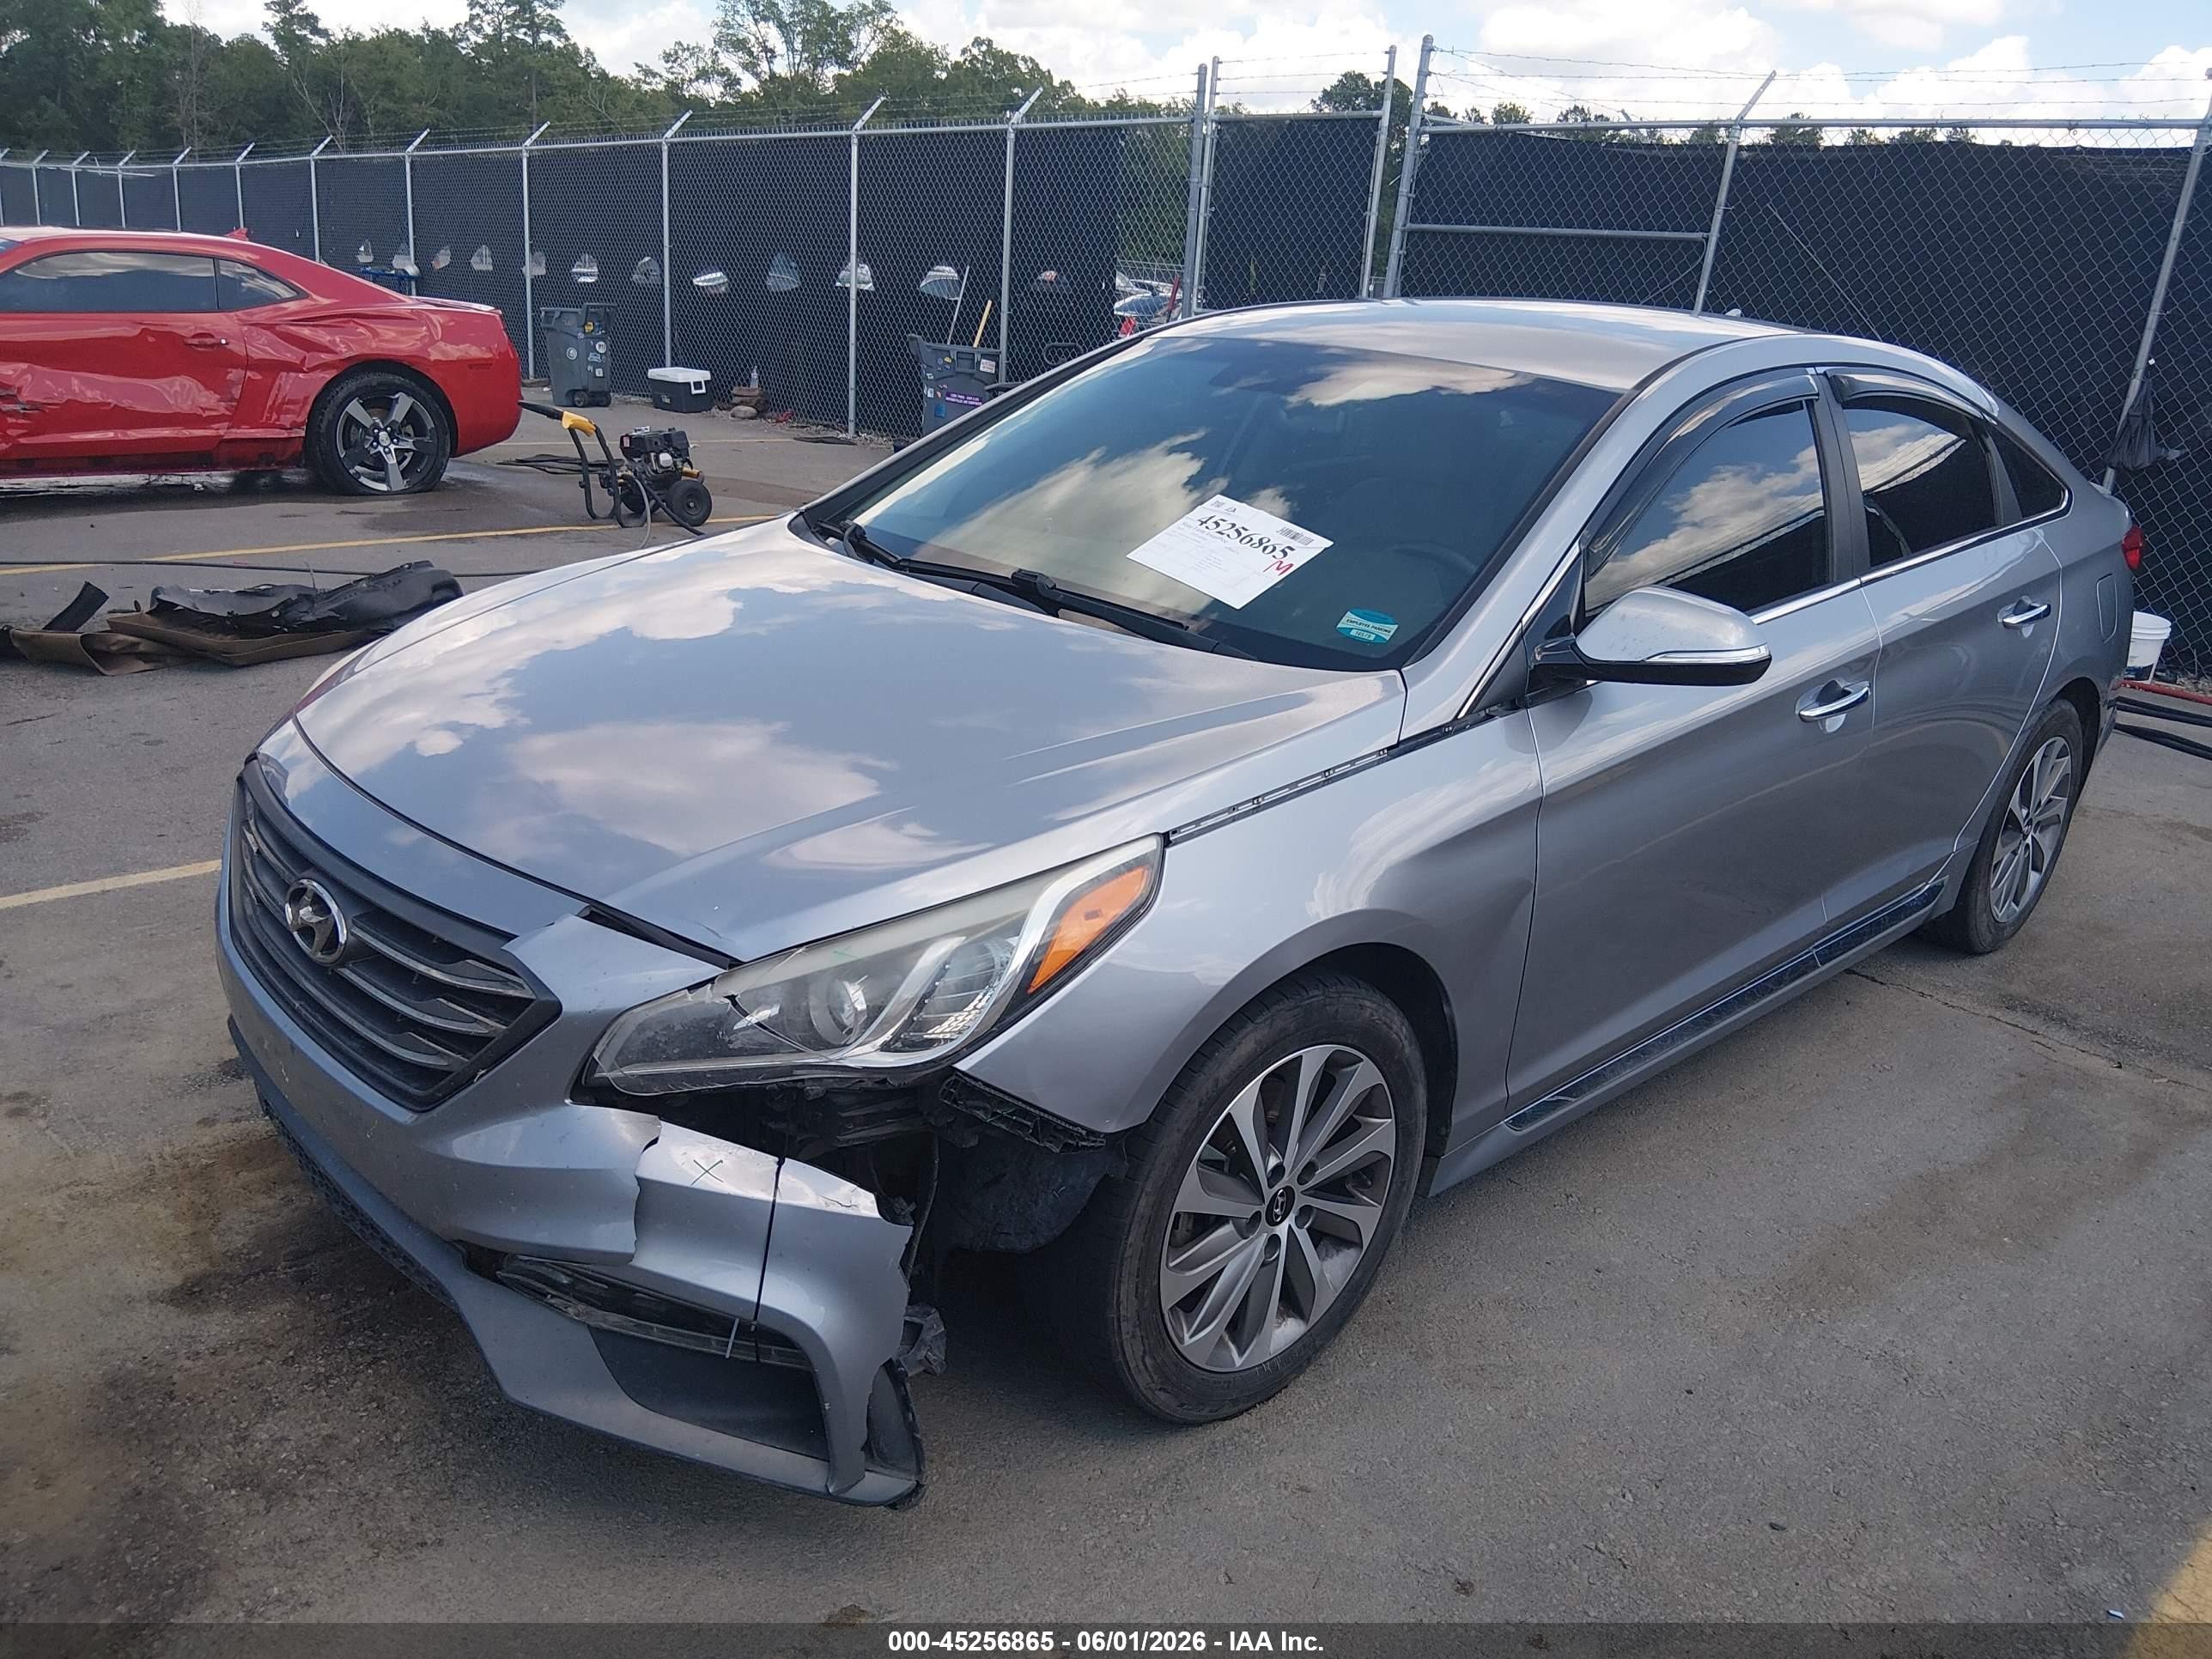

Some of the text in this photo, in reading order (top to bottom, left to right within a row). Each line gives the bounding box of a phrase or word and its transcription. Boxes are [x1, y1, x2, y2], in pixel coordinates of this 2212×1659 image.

[1197, 514, 1297, 560] 45256865
[1262, 560, 1296, 576] M
[1346, 618, 1392, 634] EMPLOYEE PARKING
